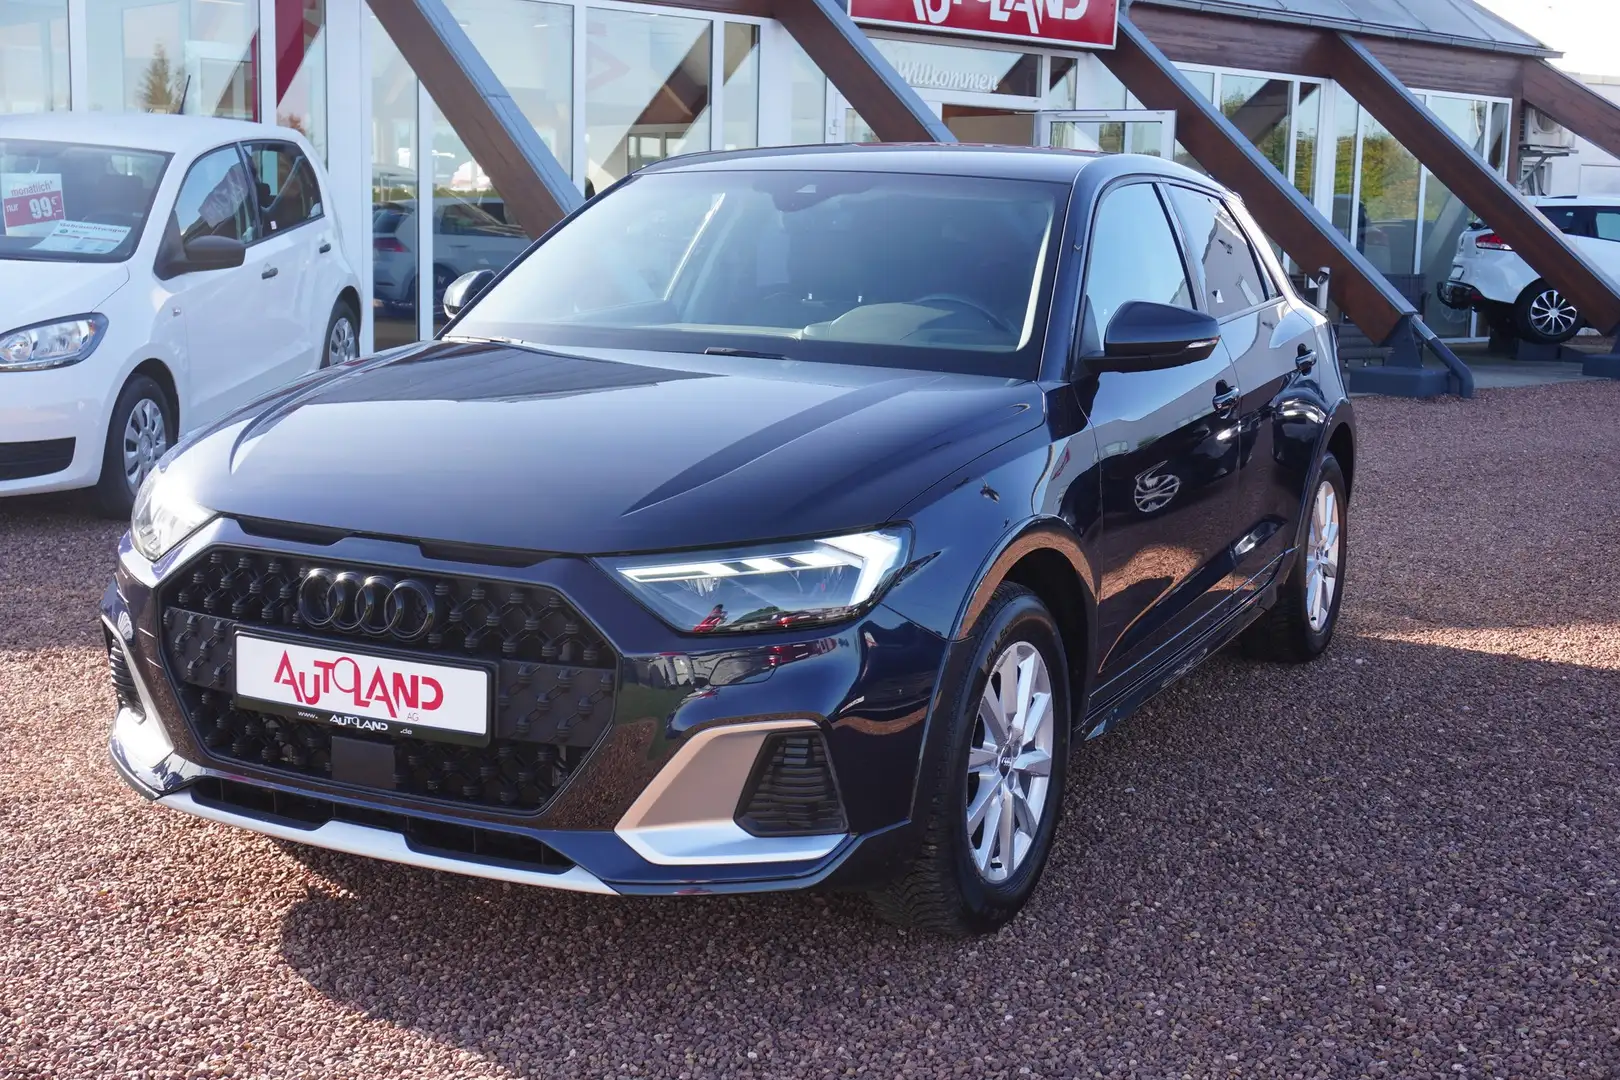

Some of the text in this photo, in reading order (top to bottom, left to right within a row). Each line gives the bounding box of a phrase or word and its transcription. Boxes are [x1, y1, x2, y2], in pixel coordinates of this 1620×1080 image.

[913, 0, 1089, 35] ULAND
[895, 60, 999, 91] Willkommen
[6, 203, 19, 213] nur
[273, 650, 444, 718] AUTOLAND
[329, 714, 389, 731] AUTOLAND
[406, 712, 419, 722] AG
